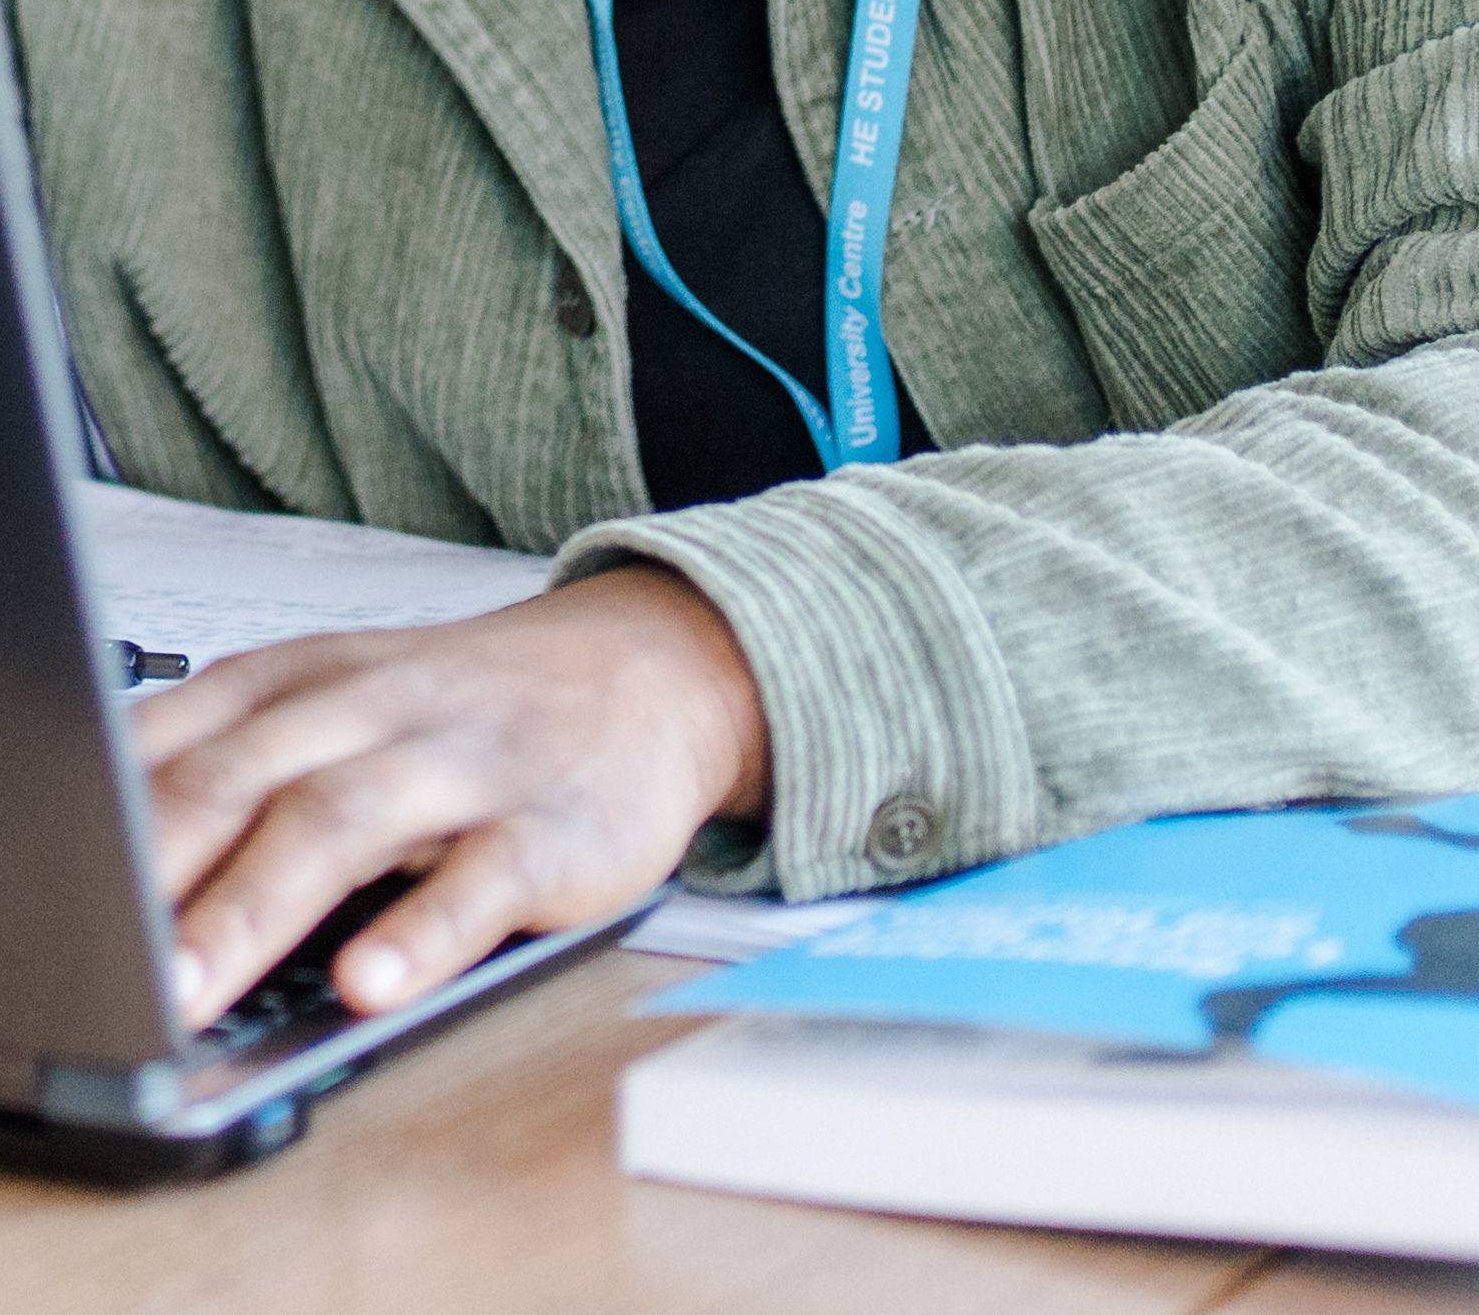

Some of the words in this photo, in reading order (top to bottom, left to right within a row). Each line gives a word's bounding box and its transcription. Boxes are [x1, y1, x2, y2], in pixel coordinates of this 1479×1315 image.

[848, 117, 879, 167] HE
[838, 199, 869, 300] Centre
[840, 304, 878, 449] University
